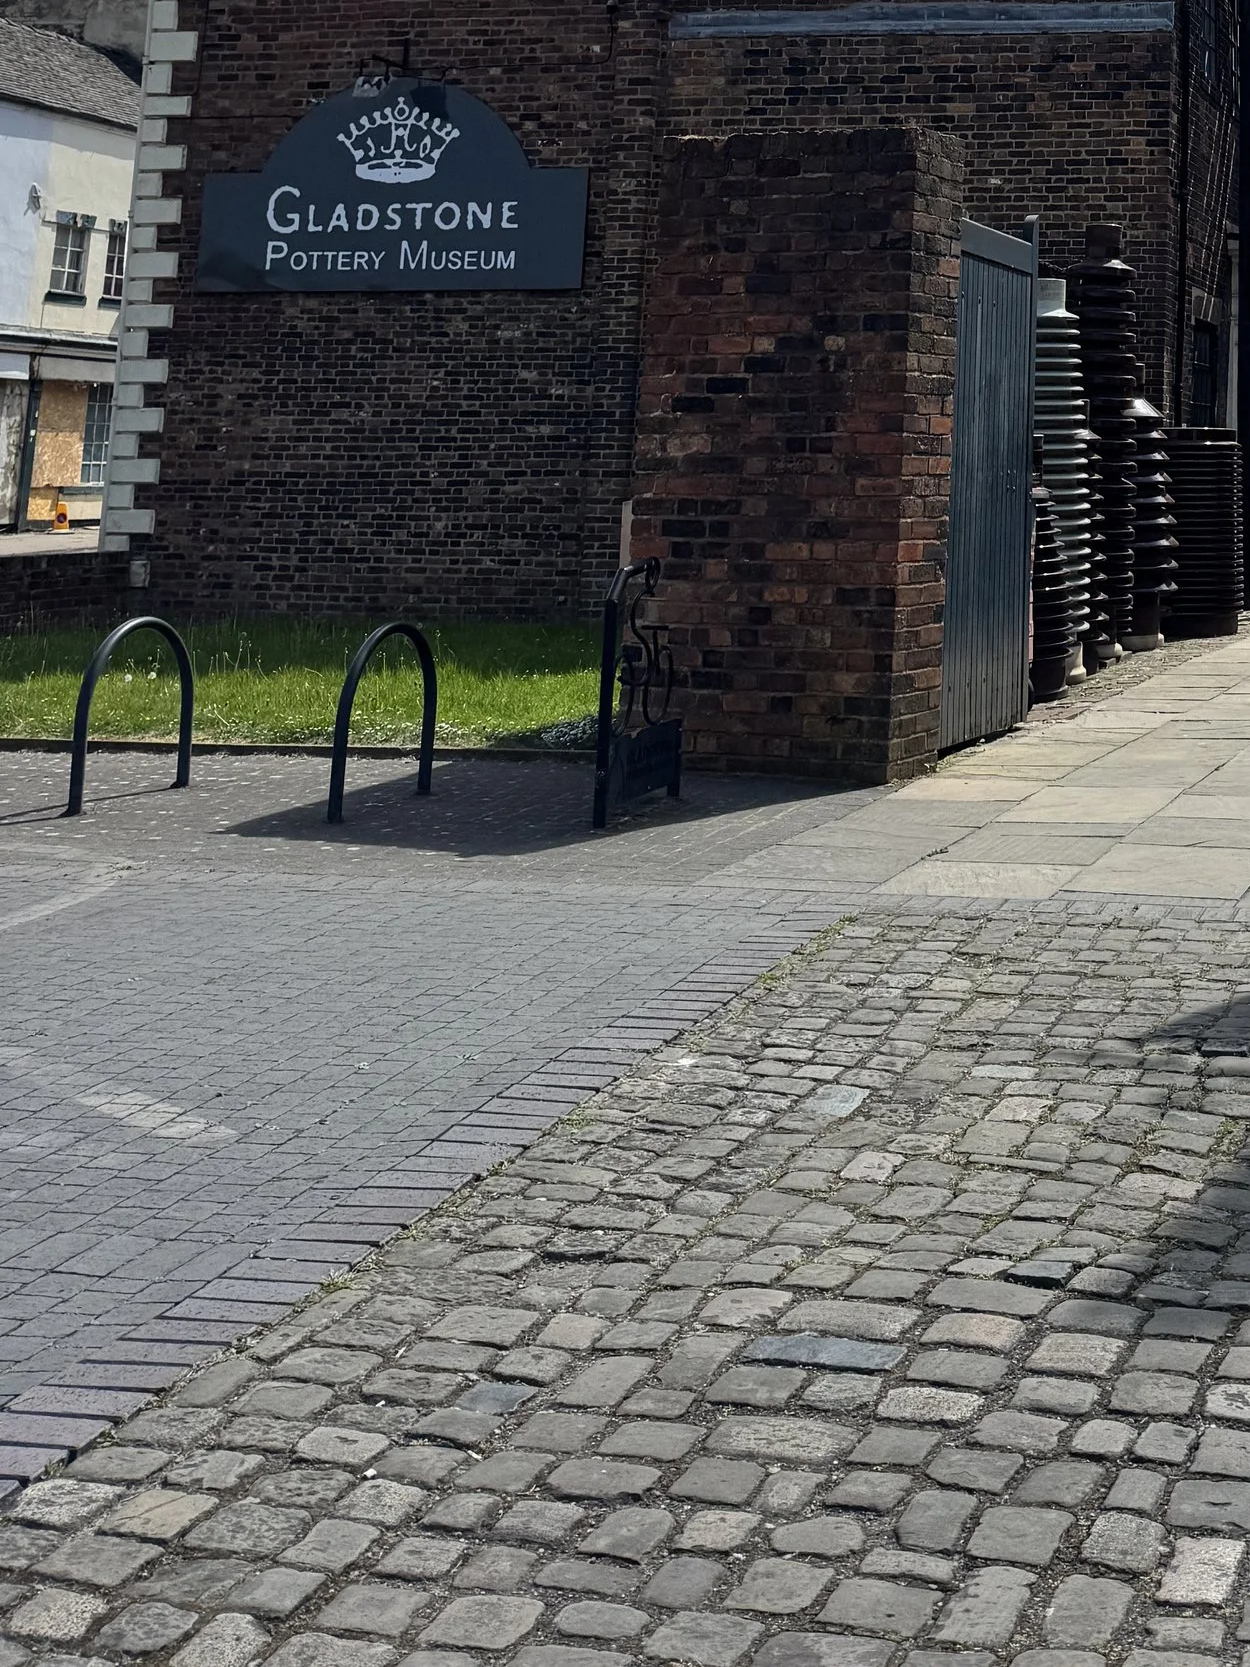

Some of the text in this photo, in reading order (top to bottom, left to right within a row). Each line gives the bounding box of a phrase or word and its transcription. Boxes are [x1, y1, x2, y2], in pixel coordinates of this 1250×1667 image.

[266, 185, 520, 234] GLADSTONE
[265, 240, 516, 271] POTTERY MUSEUM
